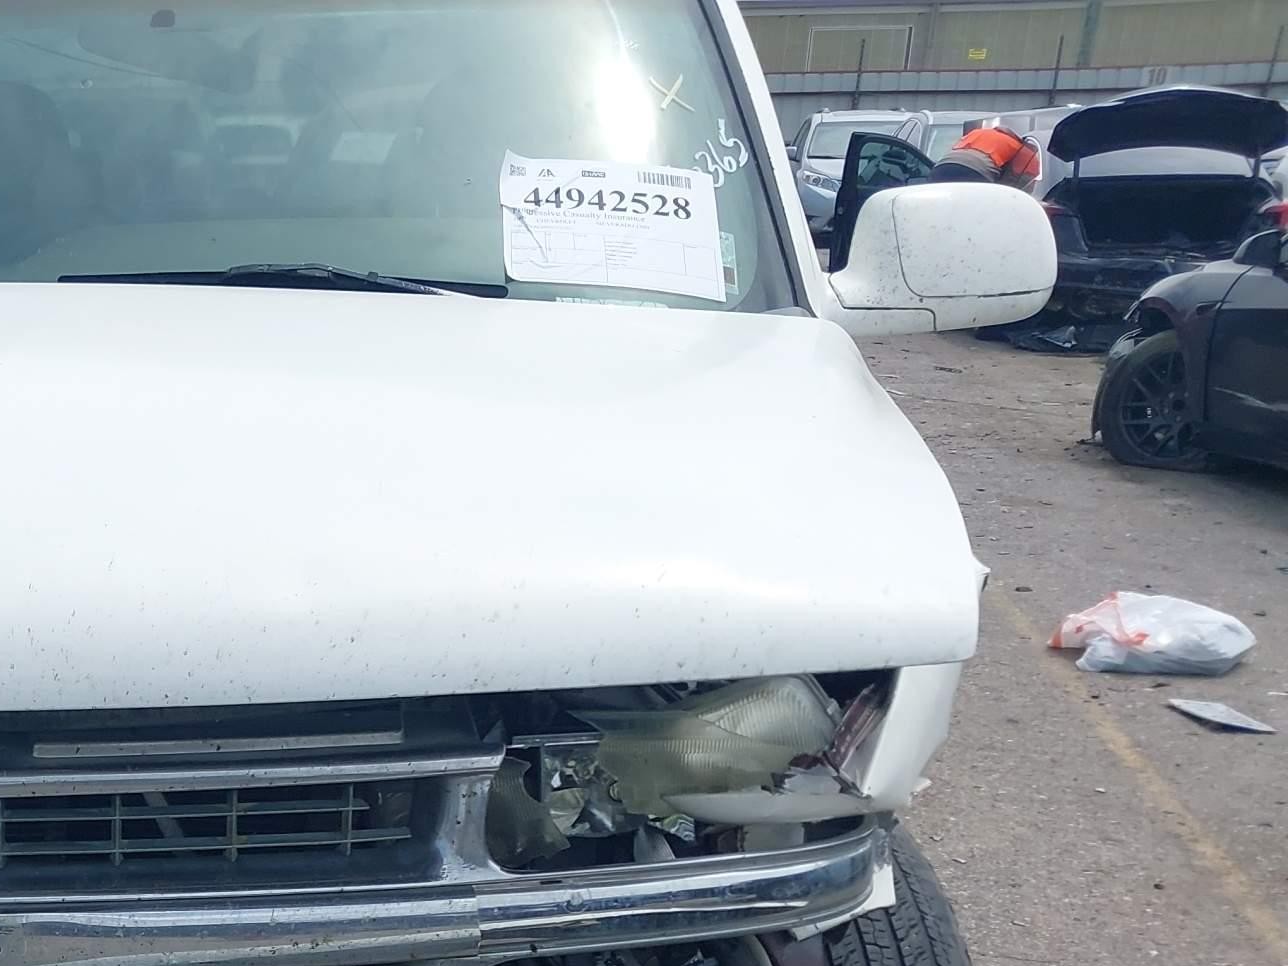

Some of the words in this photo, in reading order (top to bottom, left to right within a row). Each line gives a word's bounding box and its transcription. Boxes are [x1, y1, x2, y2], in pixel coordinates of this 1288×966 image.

[691, 118, 749, 188] 365
[523, 186, 692, 220] 44942528
[563, 209, 601, 220] Casualty
[604, 211, 646, 222] Insurance
